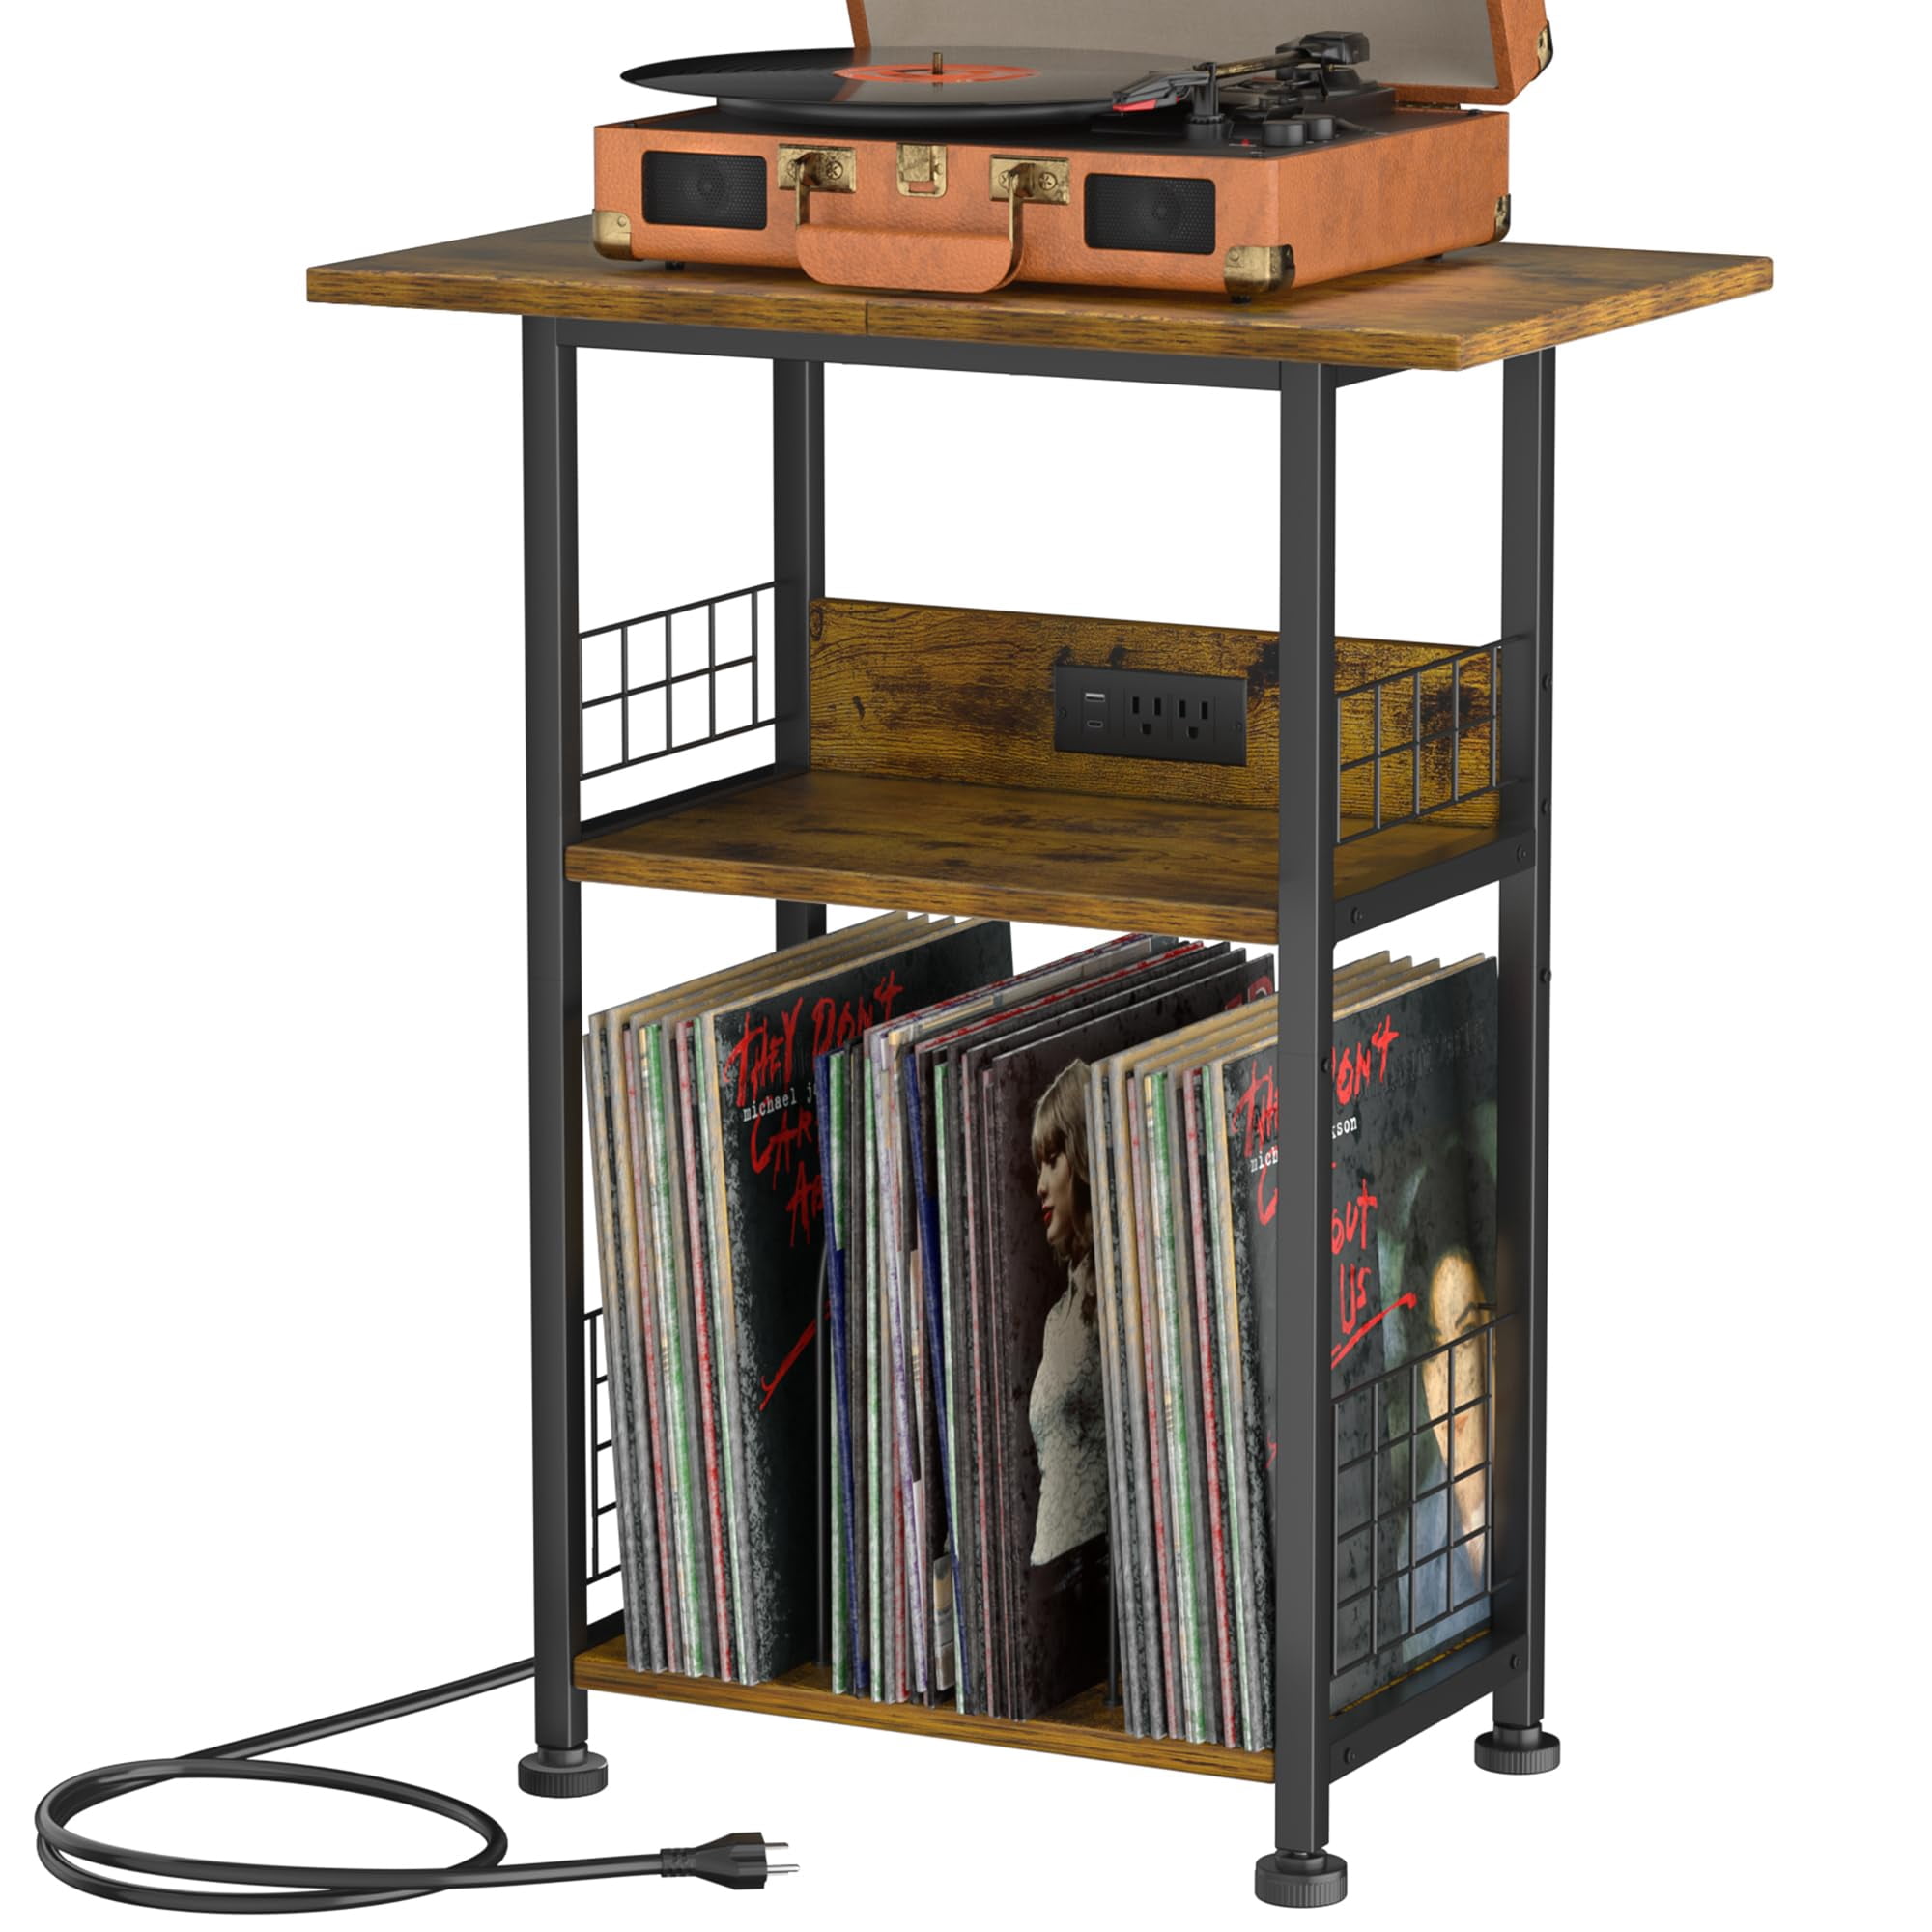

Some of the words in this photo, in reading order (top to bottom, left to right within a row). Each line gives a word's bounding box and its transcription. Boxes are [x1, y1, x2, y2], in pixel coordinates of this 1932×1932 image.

[724, 997, 804, 1107] THEY
[743, 1082, 797, 1122] michael
[750, 1107, 817, 1190] CAR
[1340, 1263, 1372, 1335] US
